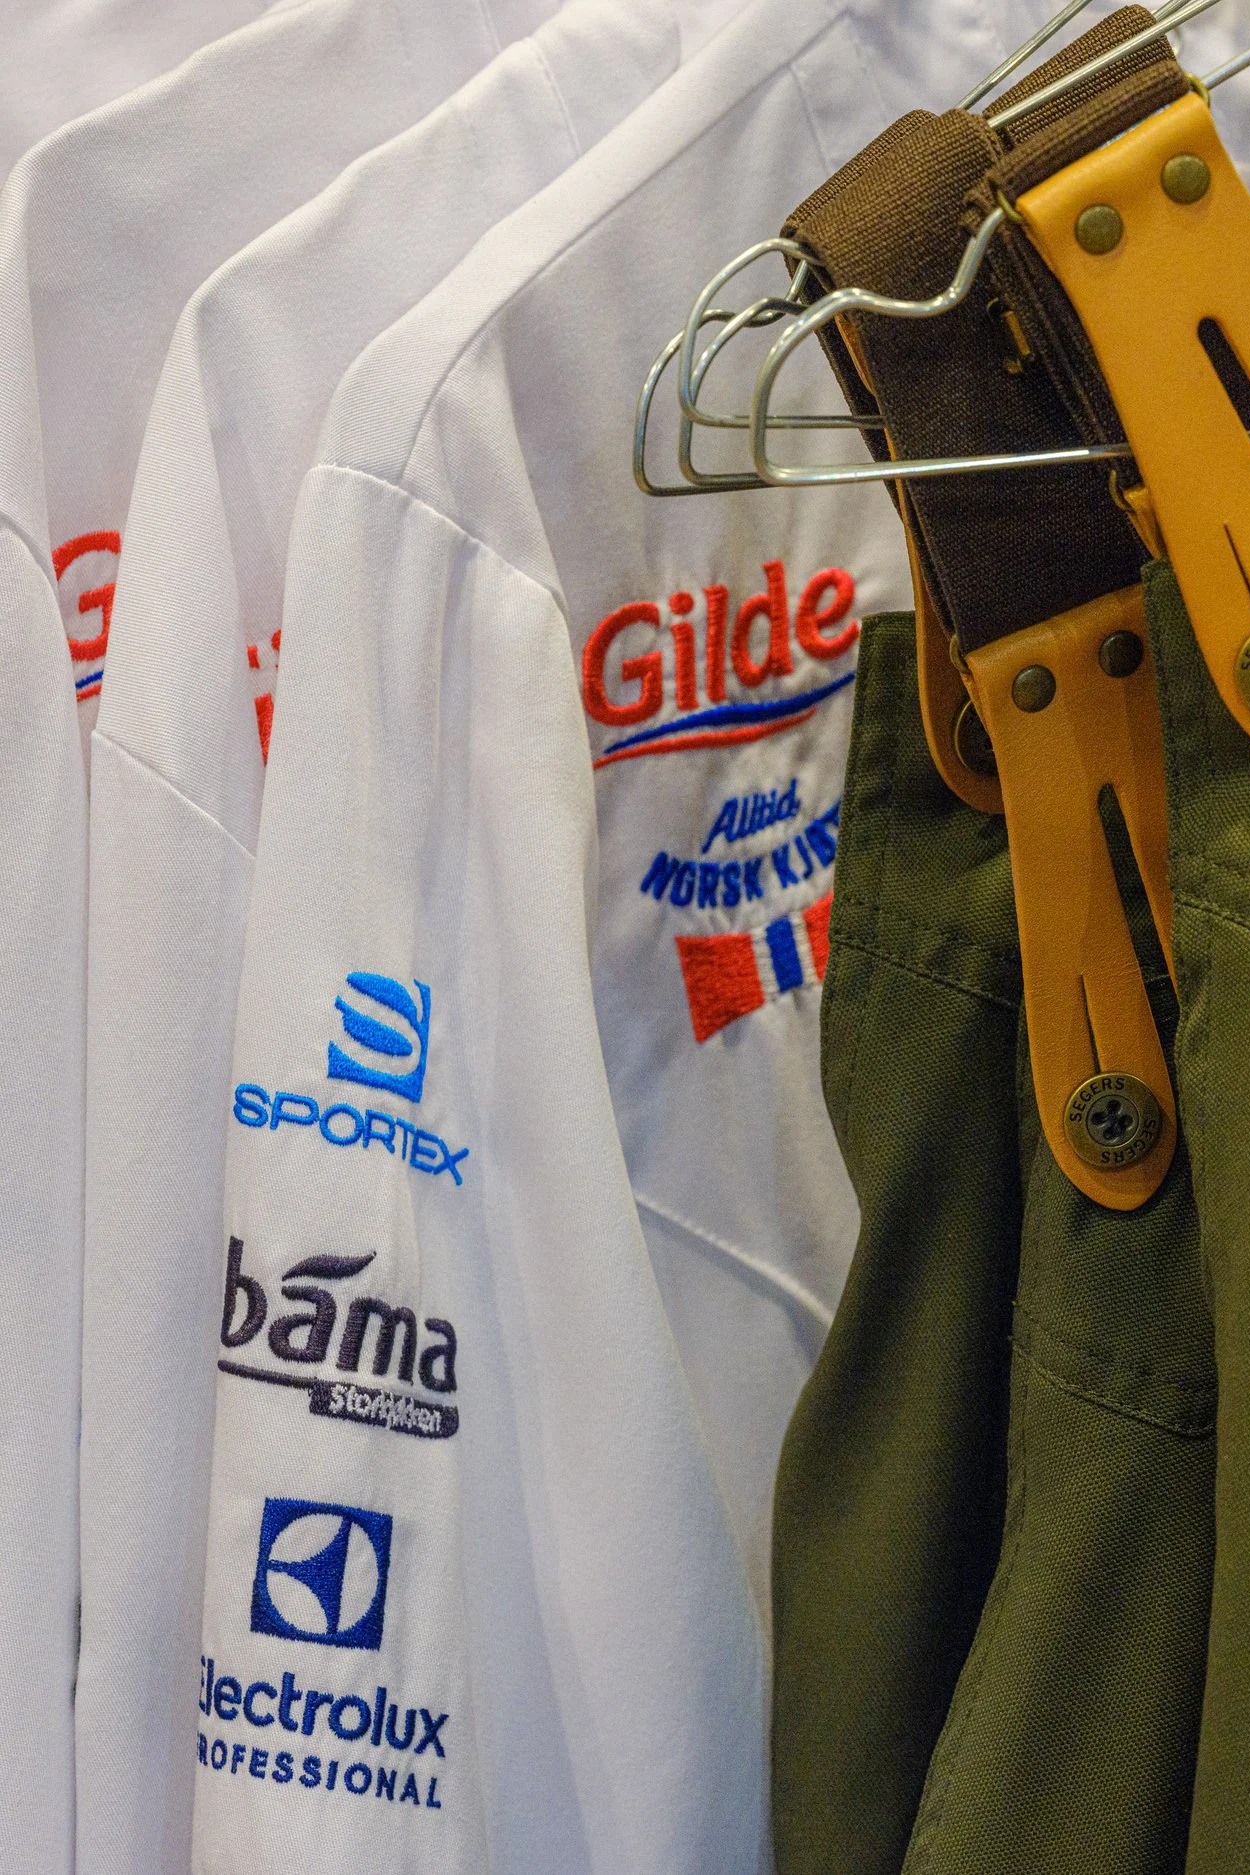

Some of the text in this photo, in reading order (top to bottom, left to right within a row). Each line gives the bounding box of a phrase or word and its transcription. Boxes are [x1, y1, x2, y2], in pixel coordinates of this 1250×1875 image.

[582, 559, 860, 728] Gilde
[701, 777, 800, 855] Alltid
[640, 851, 764, 909] NORSK
[233, 1083, 470, 1186] SPORTEX
[1069, 1077, 1125, 1122] SEGERS
[197, 1731, 441, 1809] ROFESSIONAL
